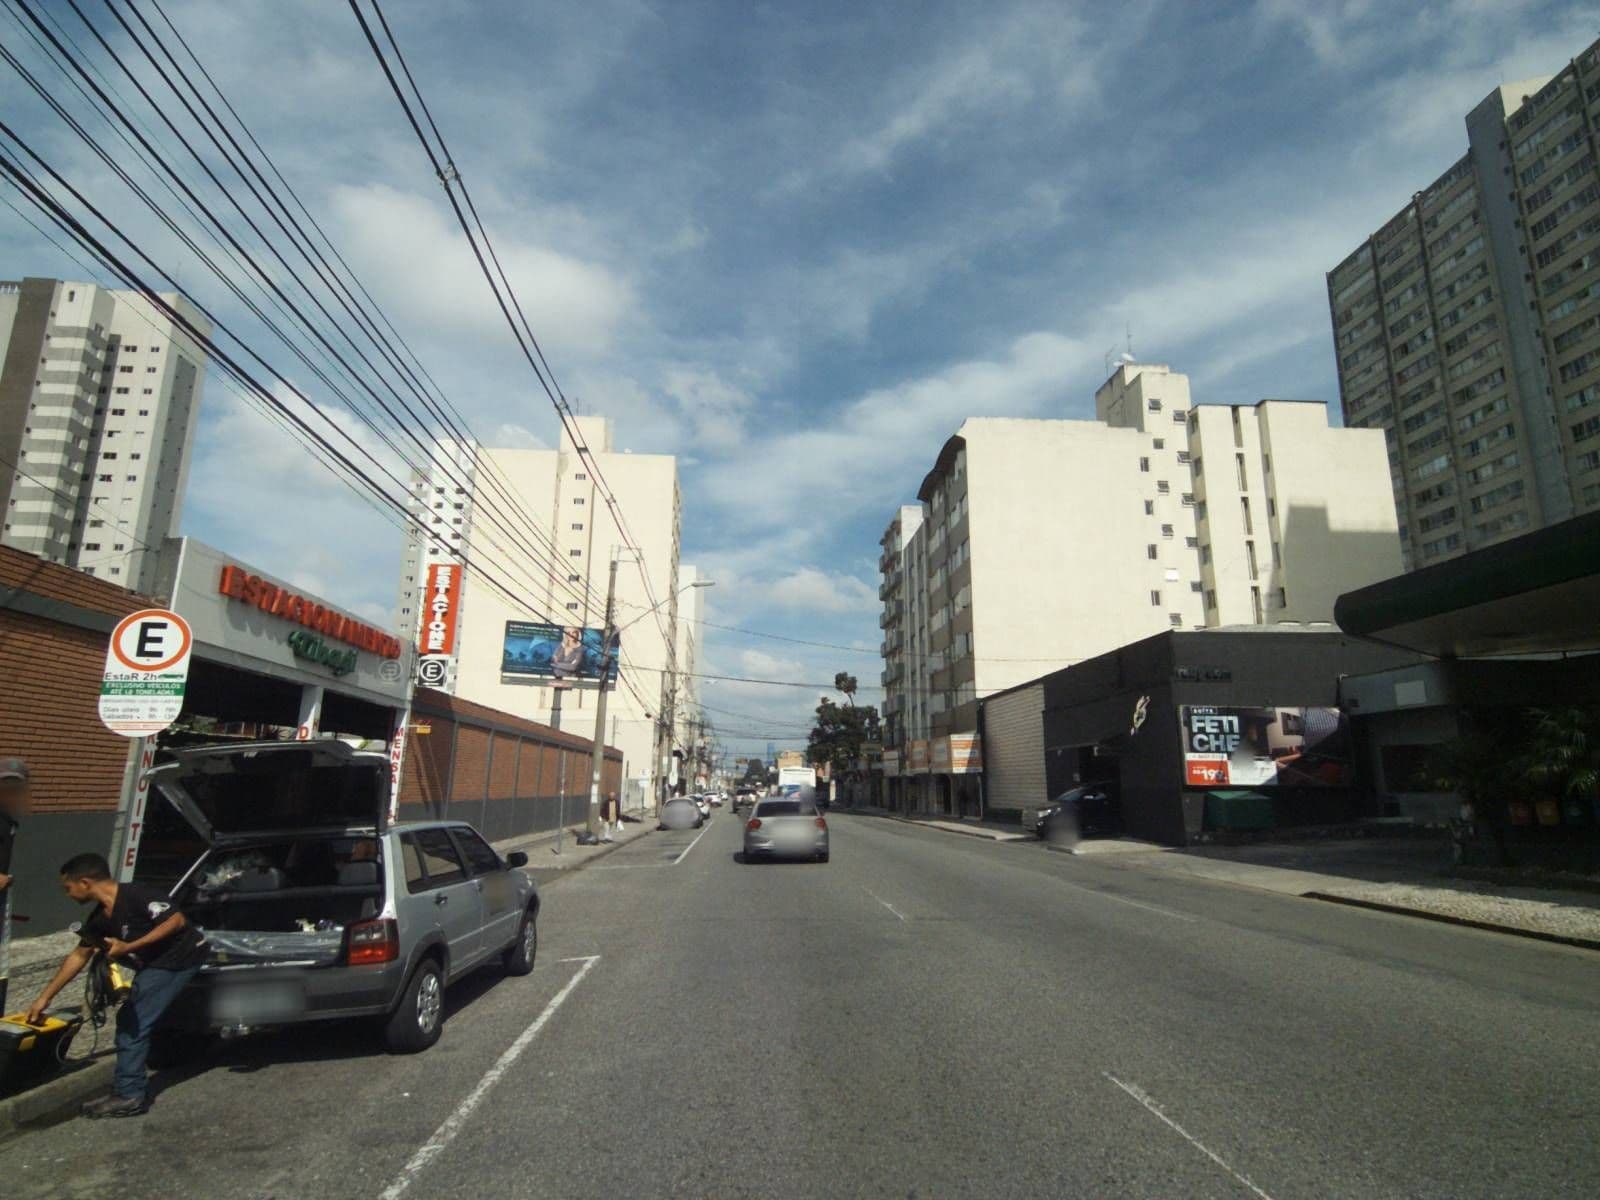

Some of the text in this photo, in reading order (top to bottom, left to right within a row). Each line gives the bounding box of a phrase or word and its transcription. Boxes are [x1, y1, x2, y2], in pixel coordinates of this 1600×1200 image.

[427, 566, 452, 650] ESTACIONE
[135, 622, 168, 658] E
[105, 672, 157, 681] EstaR 2h
[426, 664, 439, 677] E
